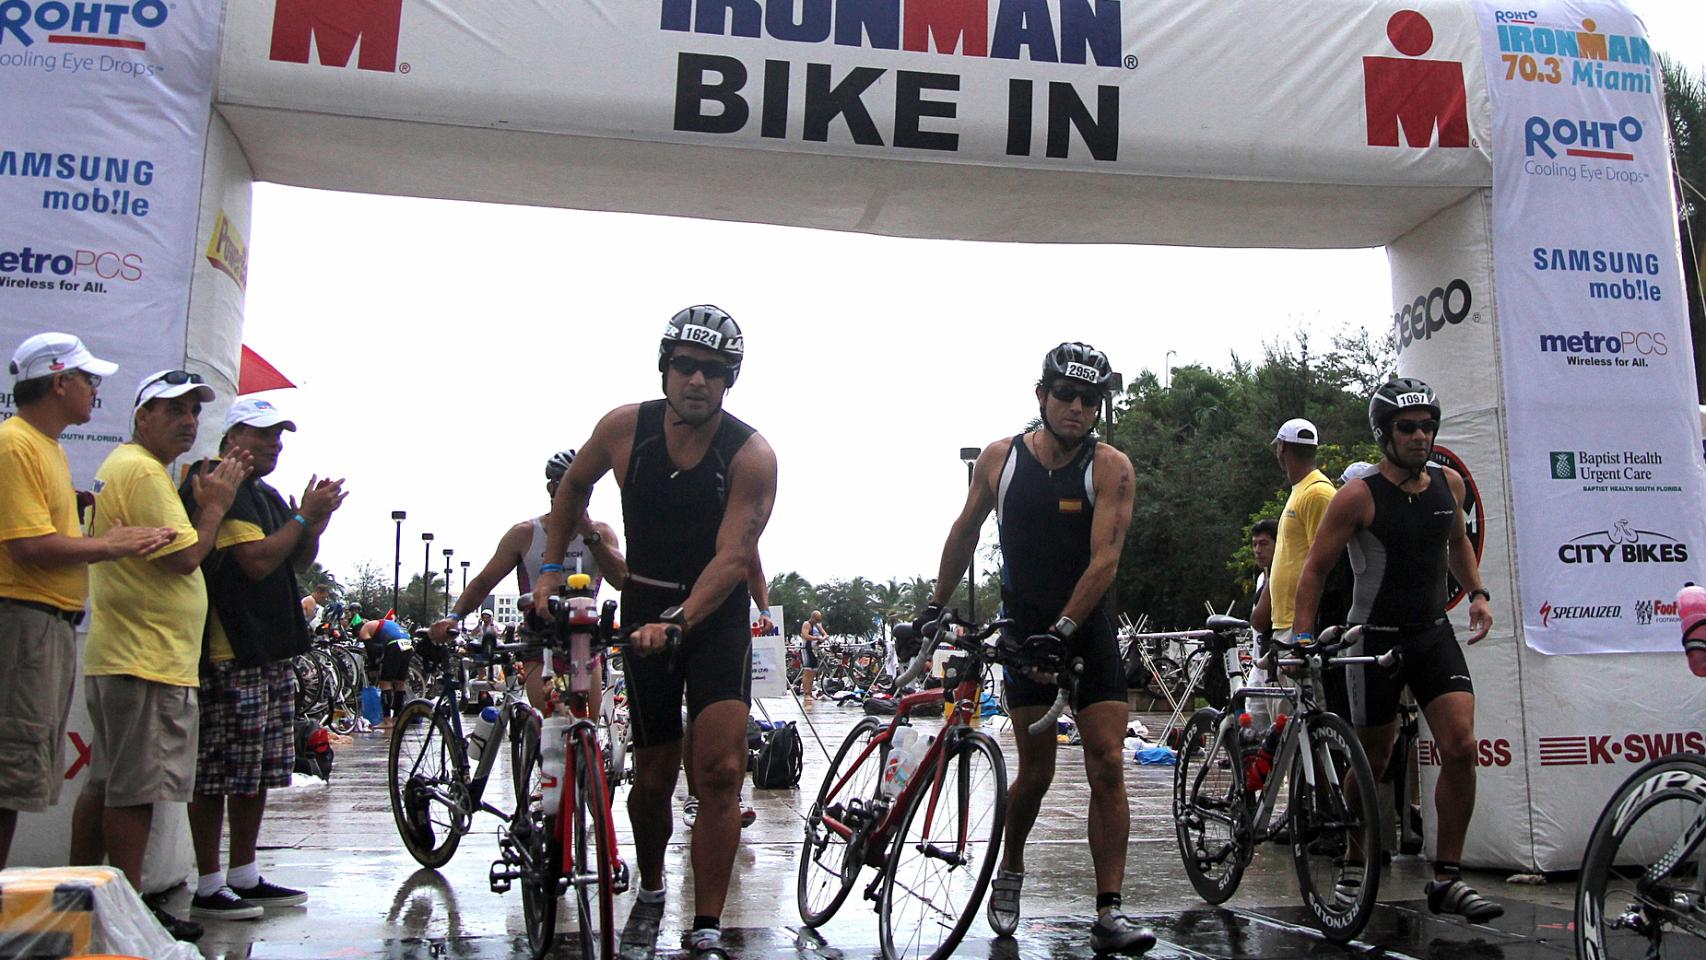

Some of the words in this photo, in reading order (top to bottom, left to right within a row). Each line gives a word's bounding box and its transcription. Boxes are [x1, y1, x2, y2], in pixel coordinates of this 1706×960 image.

[1495, 10, 1537, 23] ROHTO
[1497, 19, 1652, 66] IRONMAN
[62, 53, 94, 73] Eye
[100, 55, 154, 78] Drops
[1502, 54, 1562, 85] 70.3
[1572, 60, 1651, 94] Miami
[673, 52, 960, 151] BIKE
[1005, 78, 1119, 162] IN
[1525, 116, 1643, 159] ROHTO
[1525, 161, 1576, 181] Cooling
[1580, 165, 1602, 182] Eye
[1606, 167, 1644, 184] Drops
[1534, 248, 1659, 275] SAMSUNG
[59, 280, 80, 289] for
[83, 282, 107, 293] All.
[686, 327, 718, 346] 1624
[1540, 331, 1668, 356] metroPCS
[1567, 356, 1612, 367] Wireless
[1615, 357, 1629, 366] for
[1631, 358, 1648, 367] All.
[1069, 365, 1096, 381] 2953
[1401, 394, 1424, 405] 1097
[87, 435, 123, 443] FLORIDA
[1579, 451, 1620, 467] Baptist
[1623, 452, 1662, 464] Health
[1580, 467, 1621, 482] Urgent
[1623, 468, 1652, 479] Care
[1558, 544, 1616, 563] CITY
[1621, 544, 1688, 562] BIKES
[1552, 605, 1622, 619] SPECIALIZED
